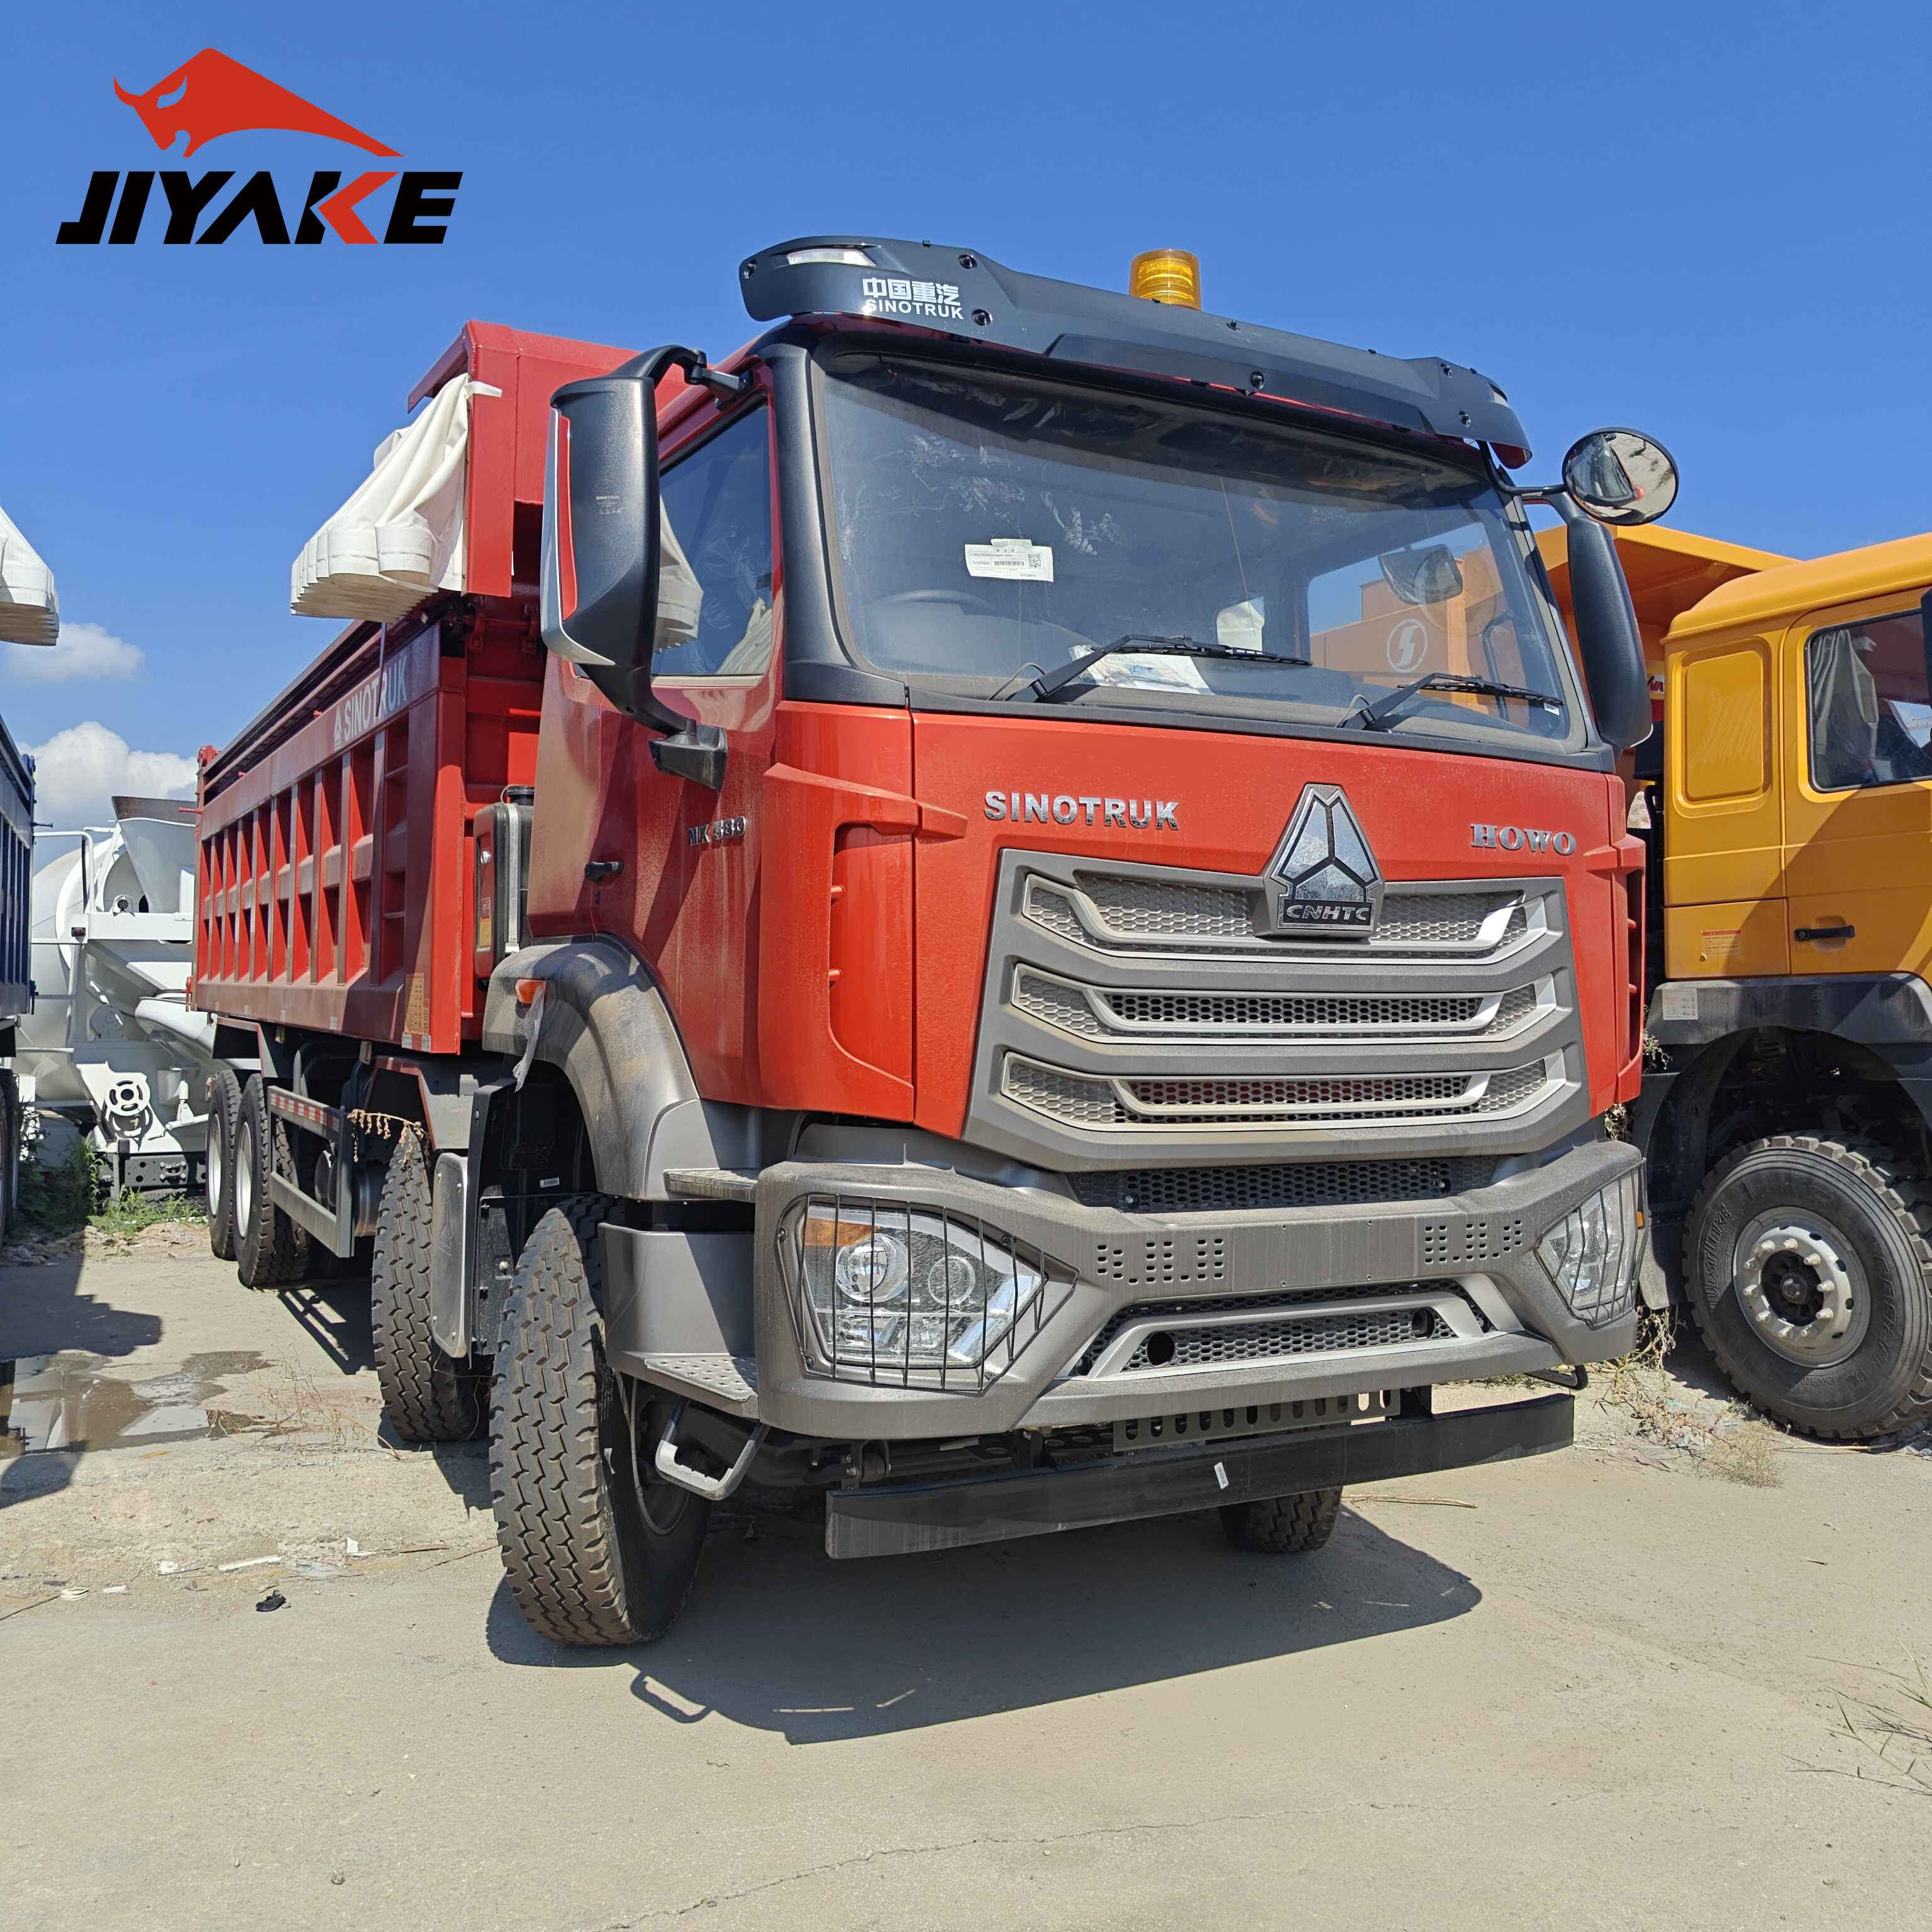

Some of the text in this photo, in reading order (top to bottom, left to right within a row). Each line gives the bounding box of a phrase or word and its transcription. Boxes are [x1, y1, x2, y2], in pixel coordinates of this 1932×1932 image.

[862, 277, 961, 306] 中国重汽
[864, 299, 964, 320] SINOTRUK
[344, 655, 408, 742] SINOTRUK
[984, 791, 1179, 830] SINOTRUK
[713, 815, 747, 841] 380
[1470, 823, 1577, 856] HOWO
[1286, 905, 1370, 921] CNHTC
